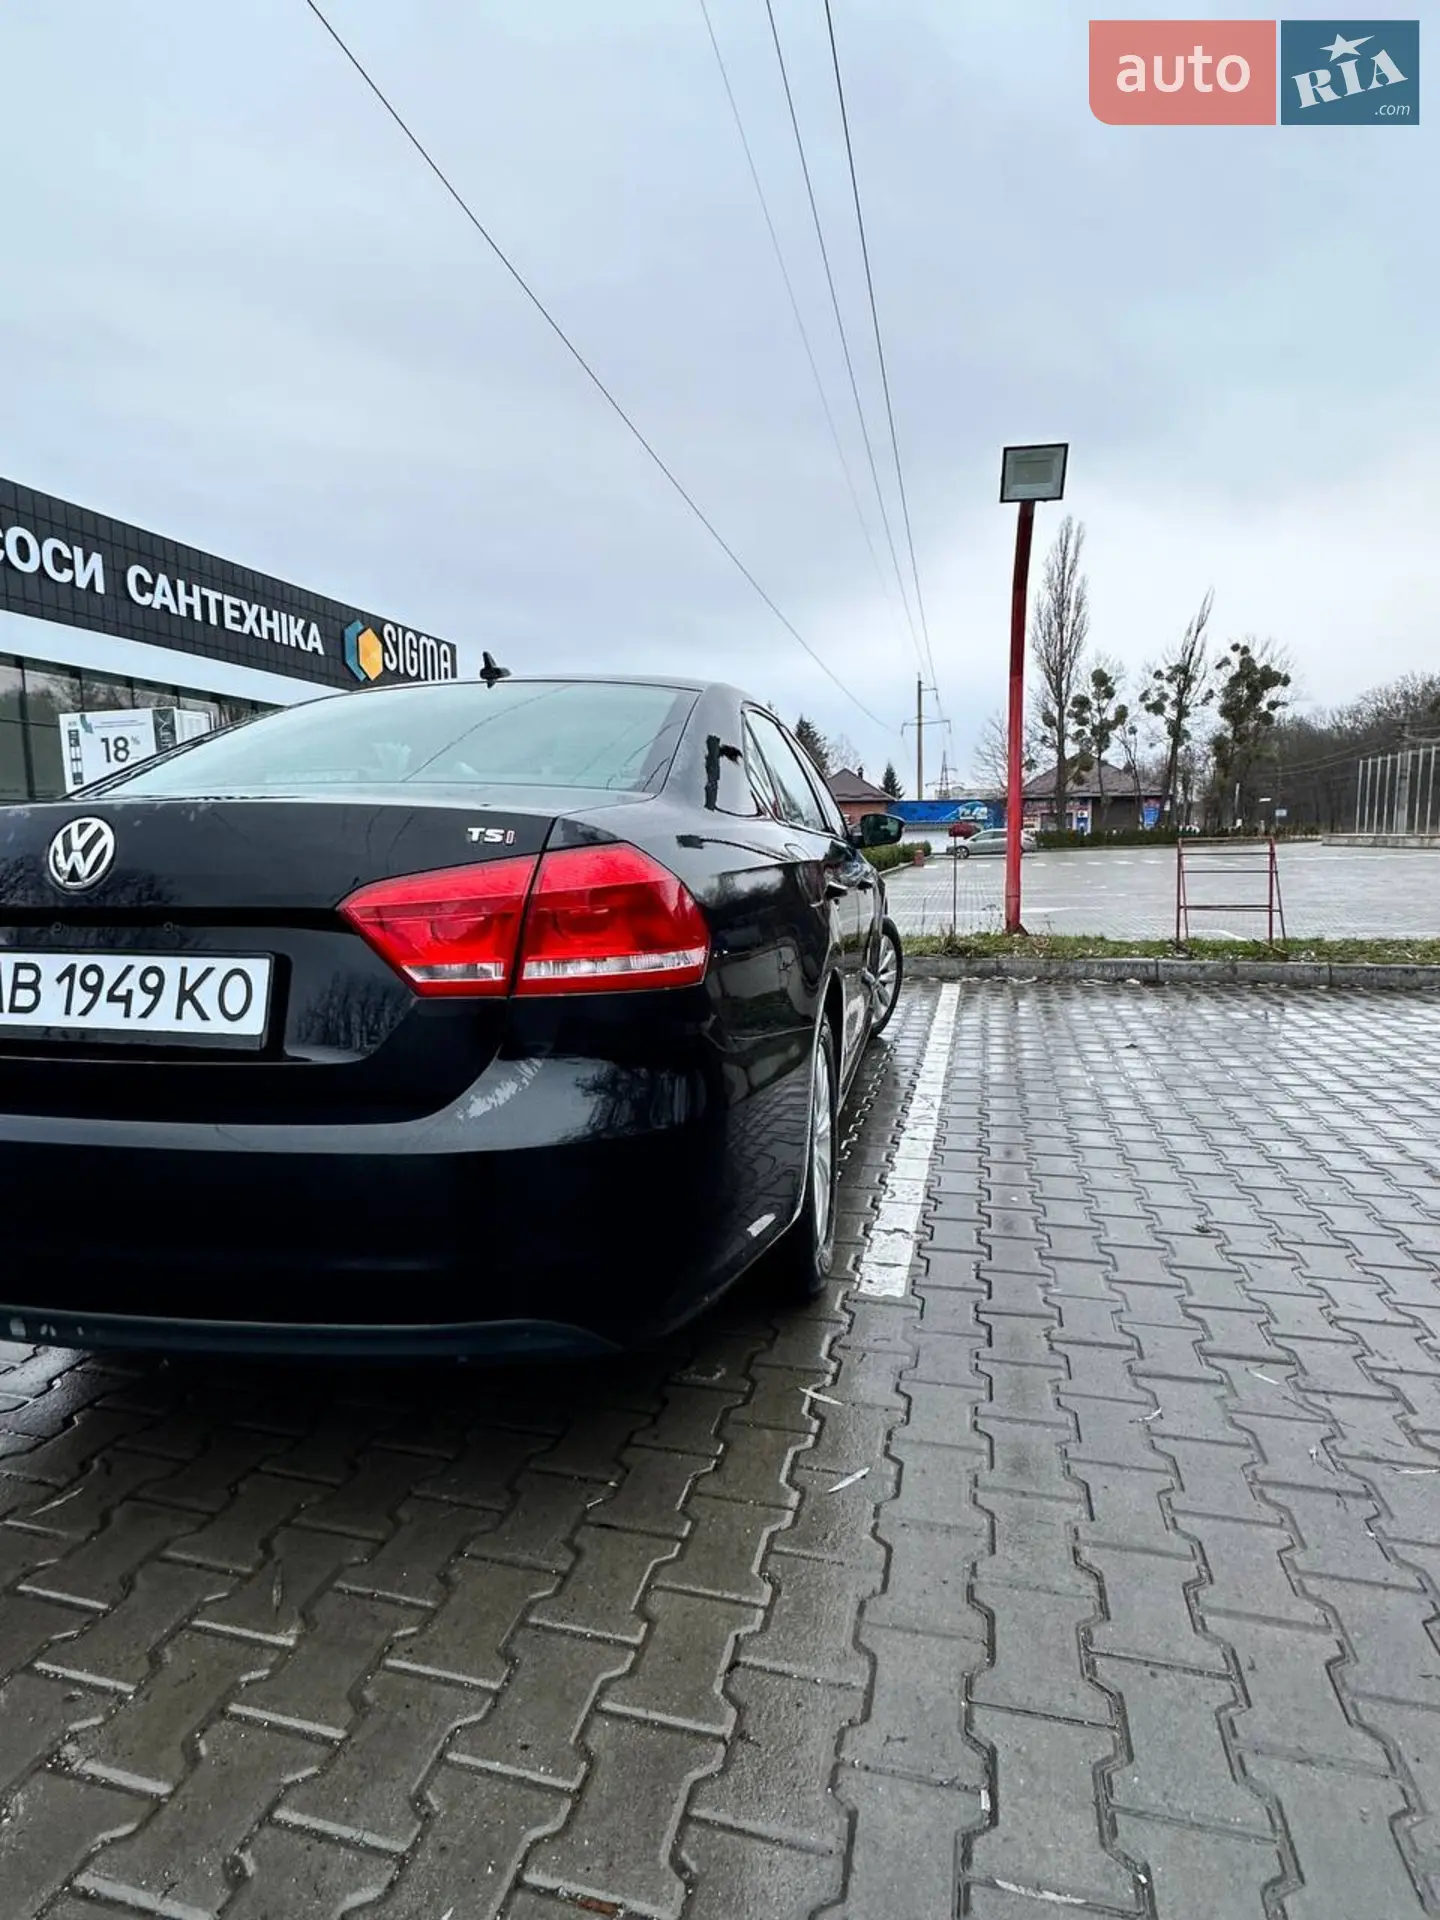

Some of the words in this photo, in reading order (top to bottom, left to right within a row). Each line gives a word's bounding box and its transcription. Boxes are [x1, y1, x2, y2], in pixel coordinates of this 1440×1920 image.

[0, 525, 105, 594] ОСИ
[126, 564, 325, 655] САНТЕХНІКА
[383, 622, 452, 681] SIGMA
[100, 736, 130, 763] 18
[0, 962, 42, 1014] B
[55, 963, 166, 1019] 1949
[175, 965, 253, 1022] KO
